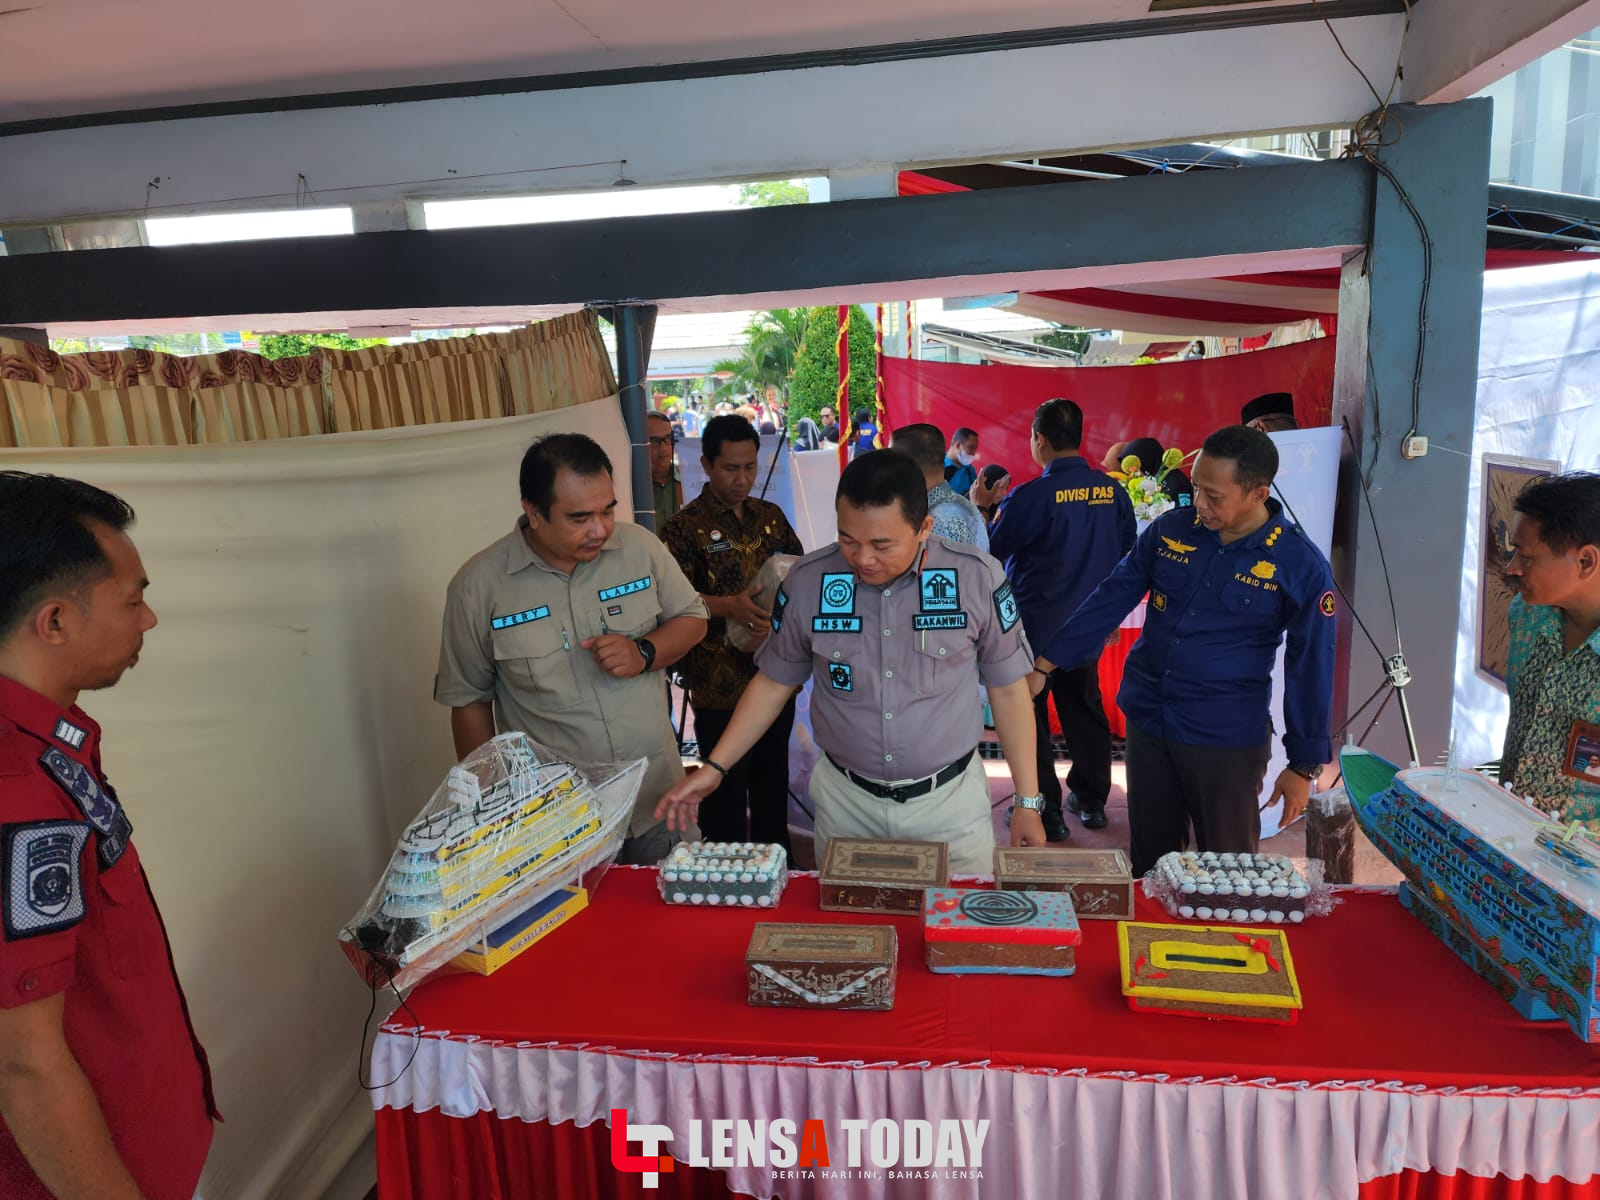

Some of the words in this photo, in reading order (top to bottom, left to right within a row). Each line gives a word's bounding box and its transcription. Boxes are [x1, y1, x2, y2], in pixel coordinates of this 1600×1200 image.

[1055, 487, 1090, 503] DIVISI
[1092, 486, 1114, 499] PAS
[604, 580, 648, 600] LAPAS
[1234, 572, 1260, 588] KABID
[1263, 582, 1279, 592] BIN
[502, 609, 539, 627] FERY
[916, 615, 965, 628] KAKANWIL
